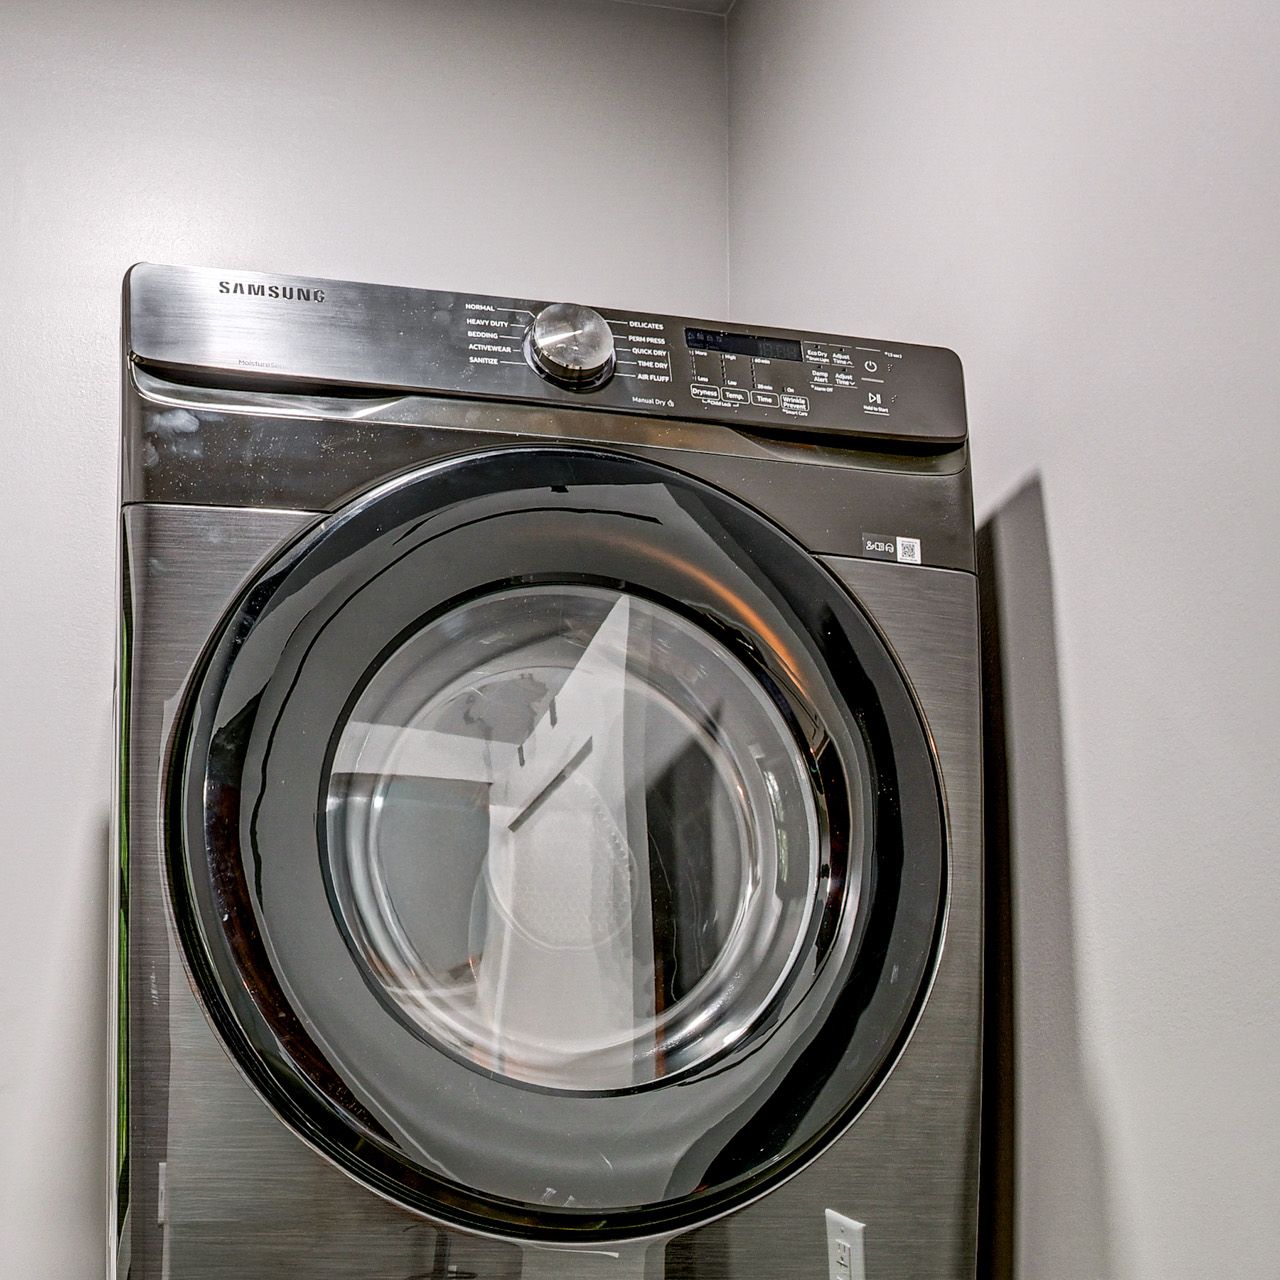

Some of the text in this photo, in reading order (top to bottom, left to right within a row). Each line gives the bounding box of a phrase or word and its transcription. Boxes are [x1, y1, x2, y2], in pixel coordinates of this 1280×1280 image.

[219, 281, 326, 303] SAMSUNG
[465, 303, 495, 312] NORMAL
[466, 318, 509, 328] HEAVY DUTY
[629, 321, 664, 330] DELICATES
[467, 331, 498, 339] BEDDING
[628, 335, 666, 345] PERM PRESS
[468, 344, 512, 353] ACTIVEWEAR
[632, 347, 667, 357] QUICK DRY
[818, 350, 828, 358] Dry
[832, 352, 850, 360] Adjust
[238, 360, 271, 368] Moisture
[469, 356, 498, 365] SANITIZE
[637, 360, 654, 368] TIME
[637, 373, 670, 383] AIR FLUFF
[811, 370, 829, 378] Damp
[692, 387, 718, 397] Dryness
[725, 392, 745, 401] Temp.
[632, 396, 667, 407] Manual Dry
[782, 396, 806, 404] Wrinkle
[783, 402, 806, 410] Prevent
